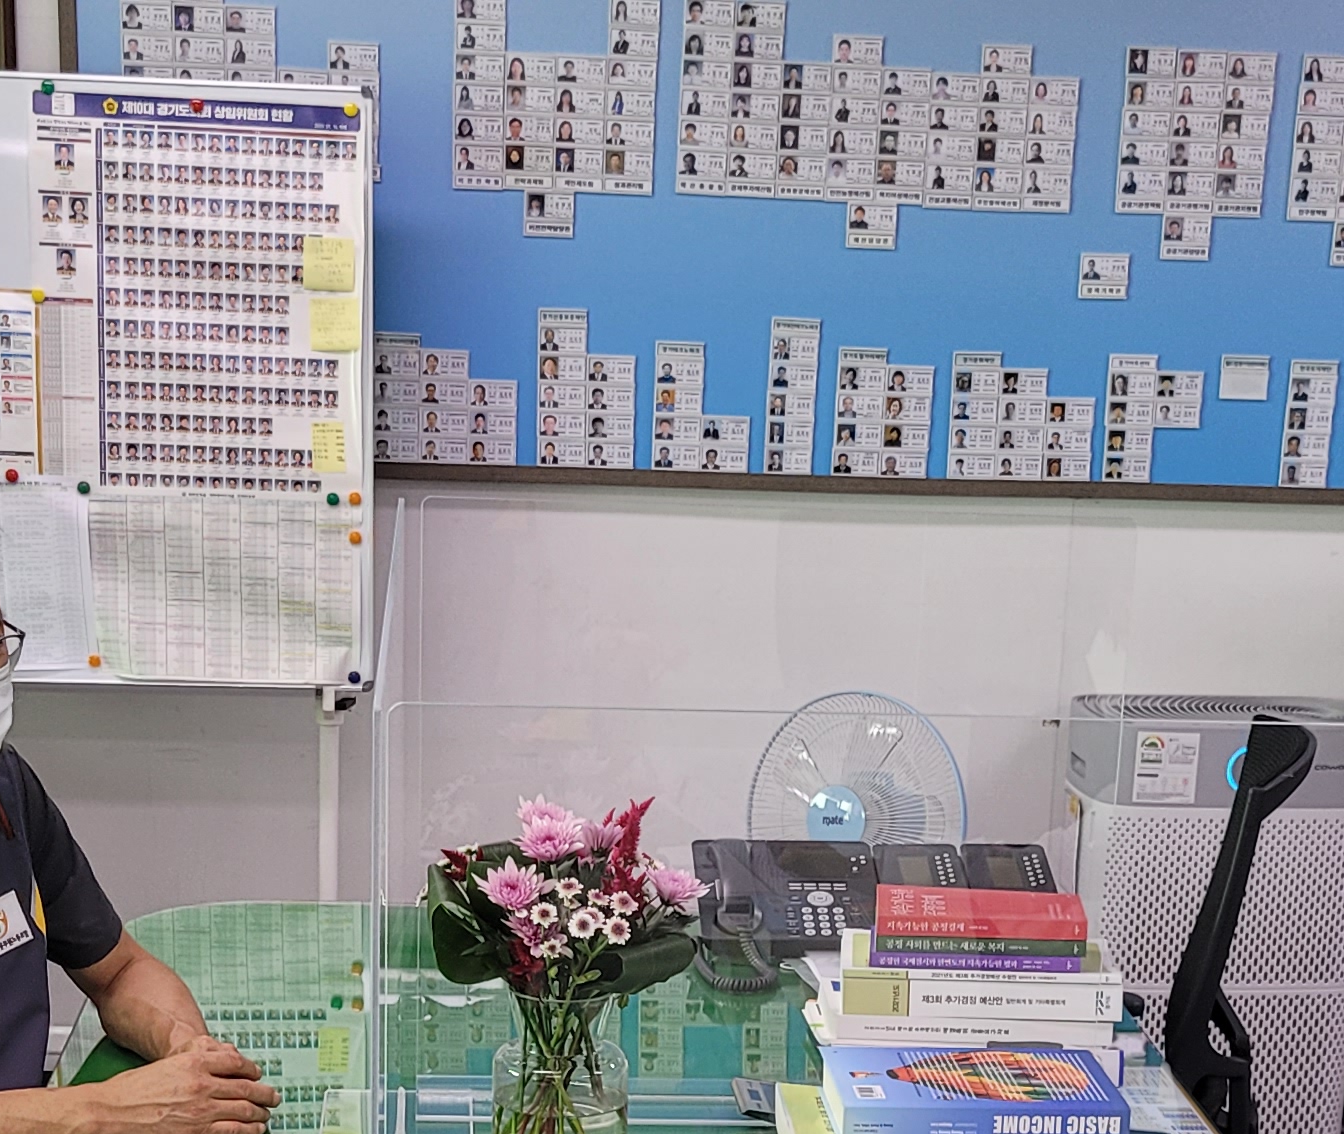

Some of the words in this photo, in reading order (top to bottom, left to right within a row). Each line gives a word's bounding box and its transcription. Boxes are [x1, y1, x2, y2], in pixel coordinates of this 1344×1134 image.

[121, 100, 154, 116] 제10대
[156, 102, 212, 119] 경기도회
[214, 105, 269, 122] 상임위원회
[271, 106, 294, 123] 현황
[921, 994, 943, 1004] 제3회
[979, 996, 1003, 1006] 예산안
[992, 1114, 1062, 1134] INCOME
[1067, 1115, 1121, 1134] BASIC
